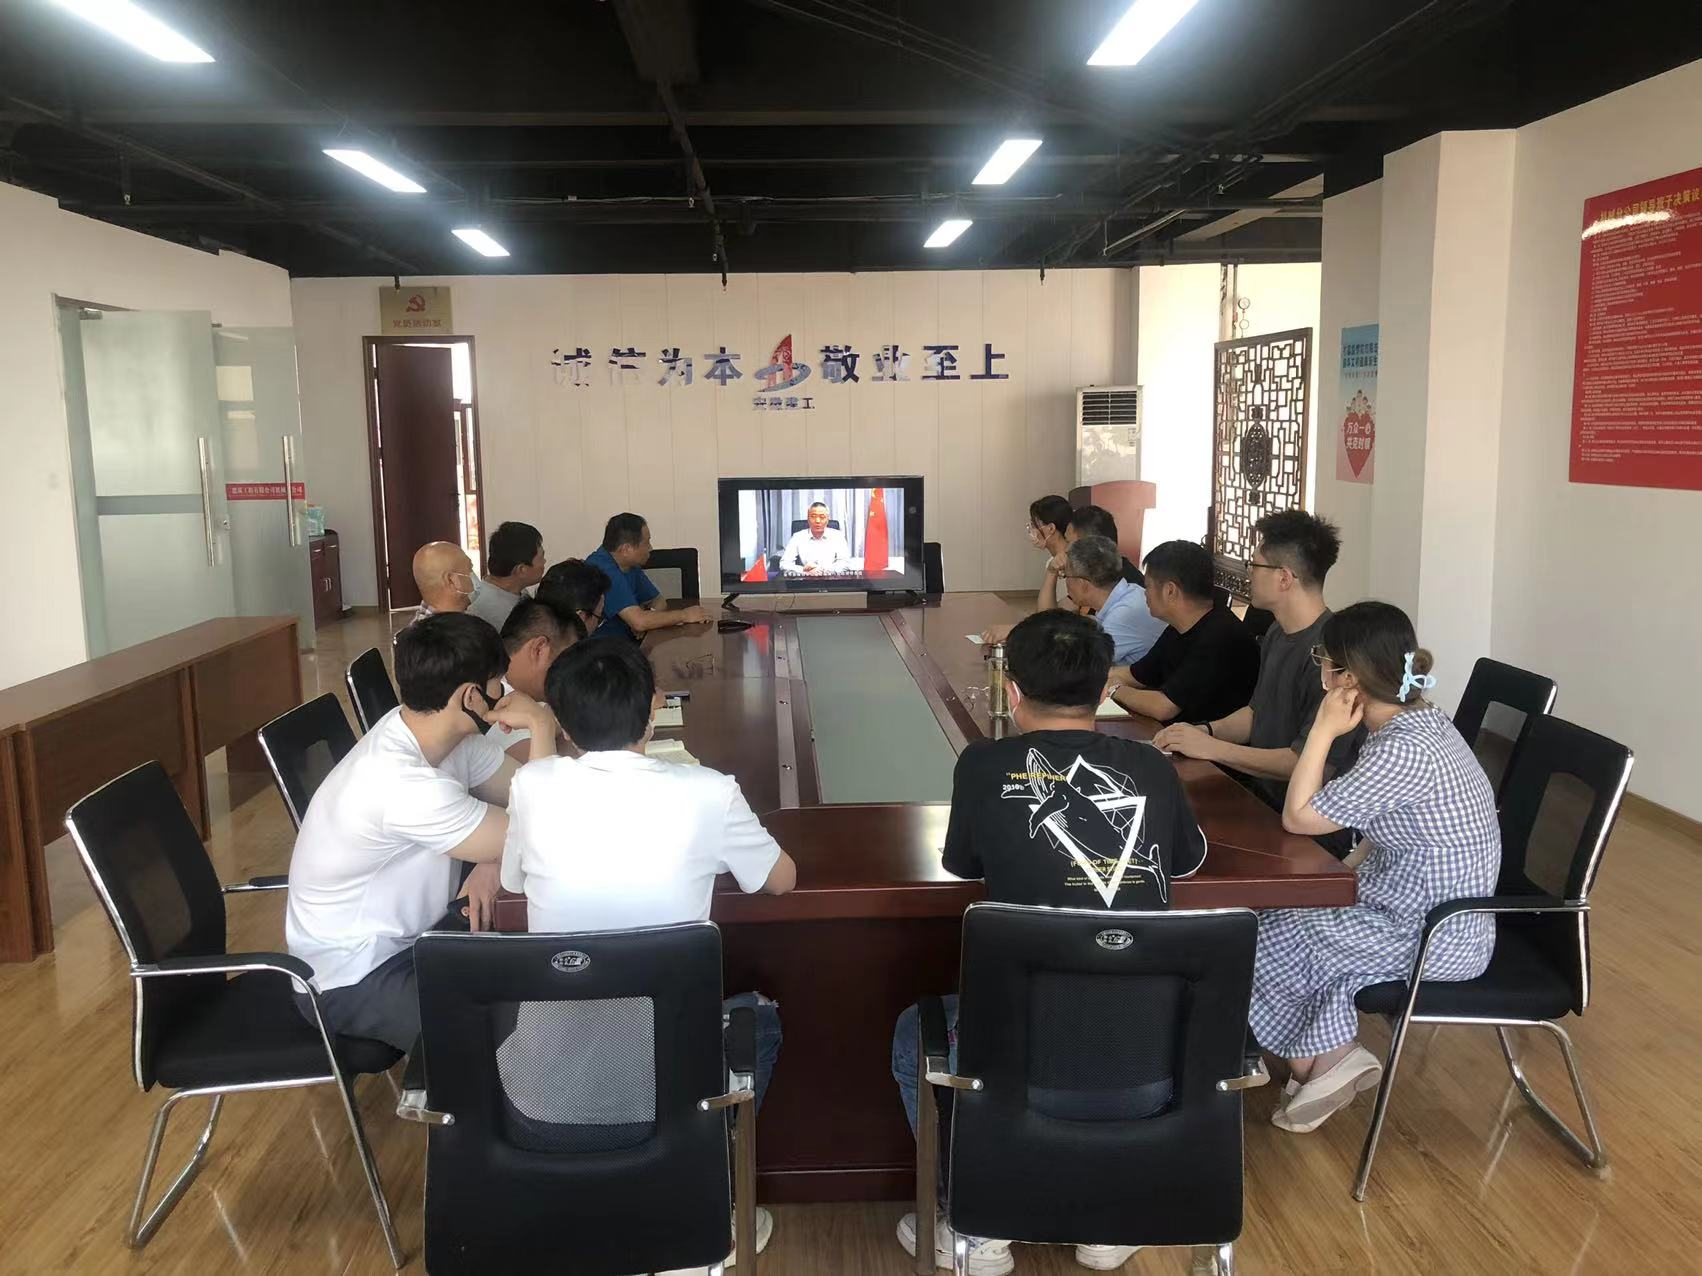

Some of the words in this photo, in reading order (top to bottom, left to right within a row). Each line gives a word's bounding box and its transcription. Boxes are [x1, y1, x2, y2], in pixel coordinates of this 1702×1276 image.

[551, 346, 743, 387] 诚信为本
[820, 343, 1010, 384] 敬业至上
[1347, 422, 1371, 435] 万众一心
